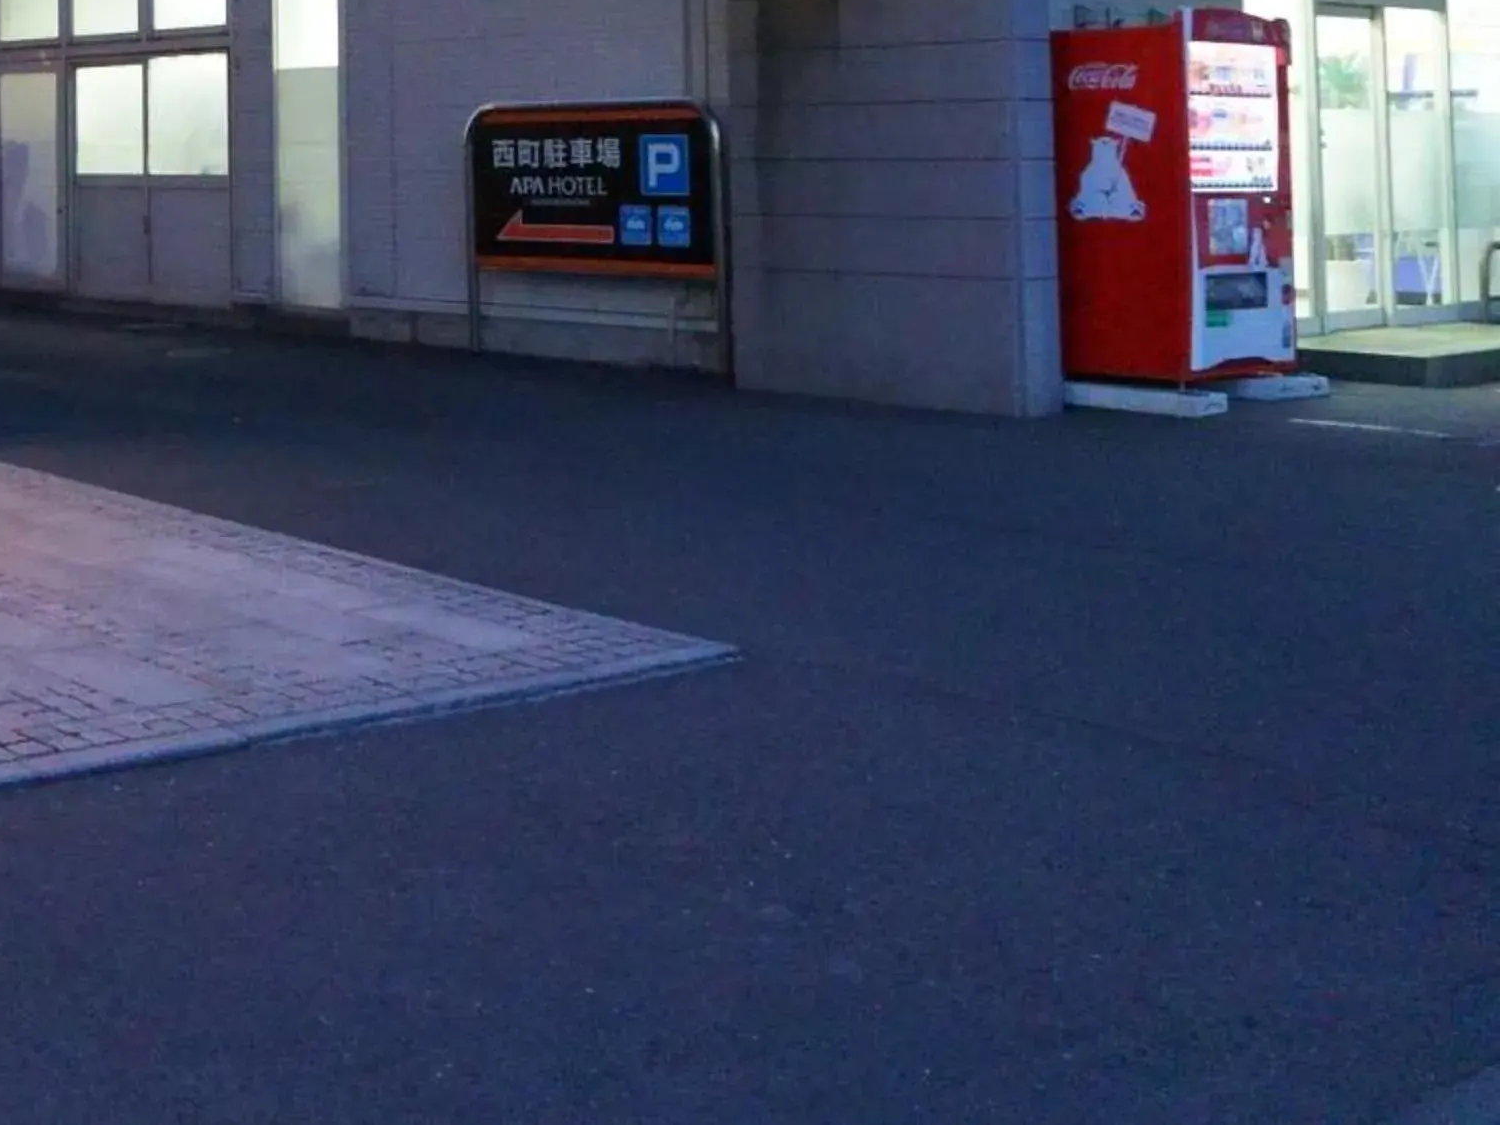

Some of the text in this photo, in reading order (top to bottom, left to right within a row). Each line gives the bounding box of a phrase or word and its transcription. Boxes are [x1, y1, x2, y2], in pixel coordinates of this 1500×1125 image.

[491, 138, 621, 169] 西町駐車場
[647, 143, 680, 189] P
[510, 176, 608, 196] APA HOTEL
